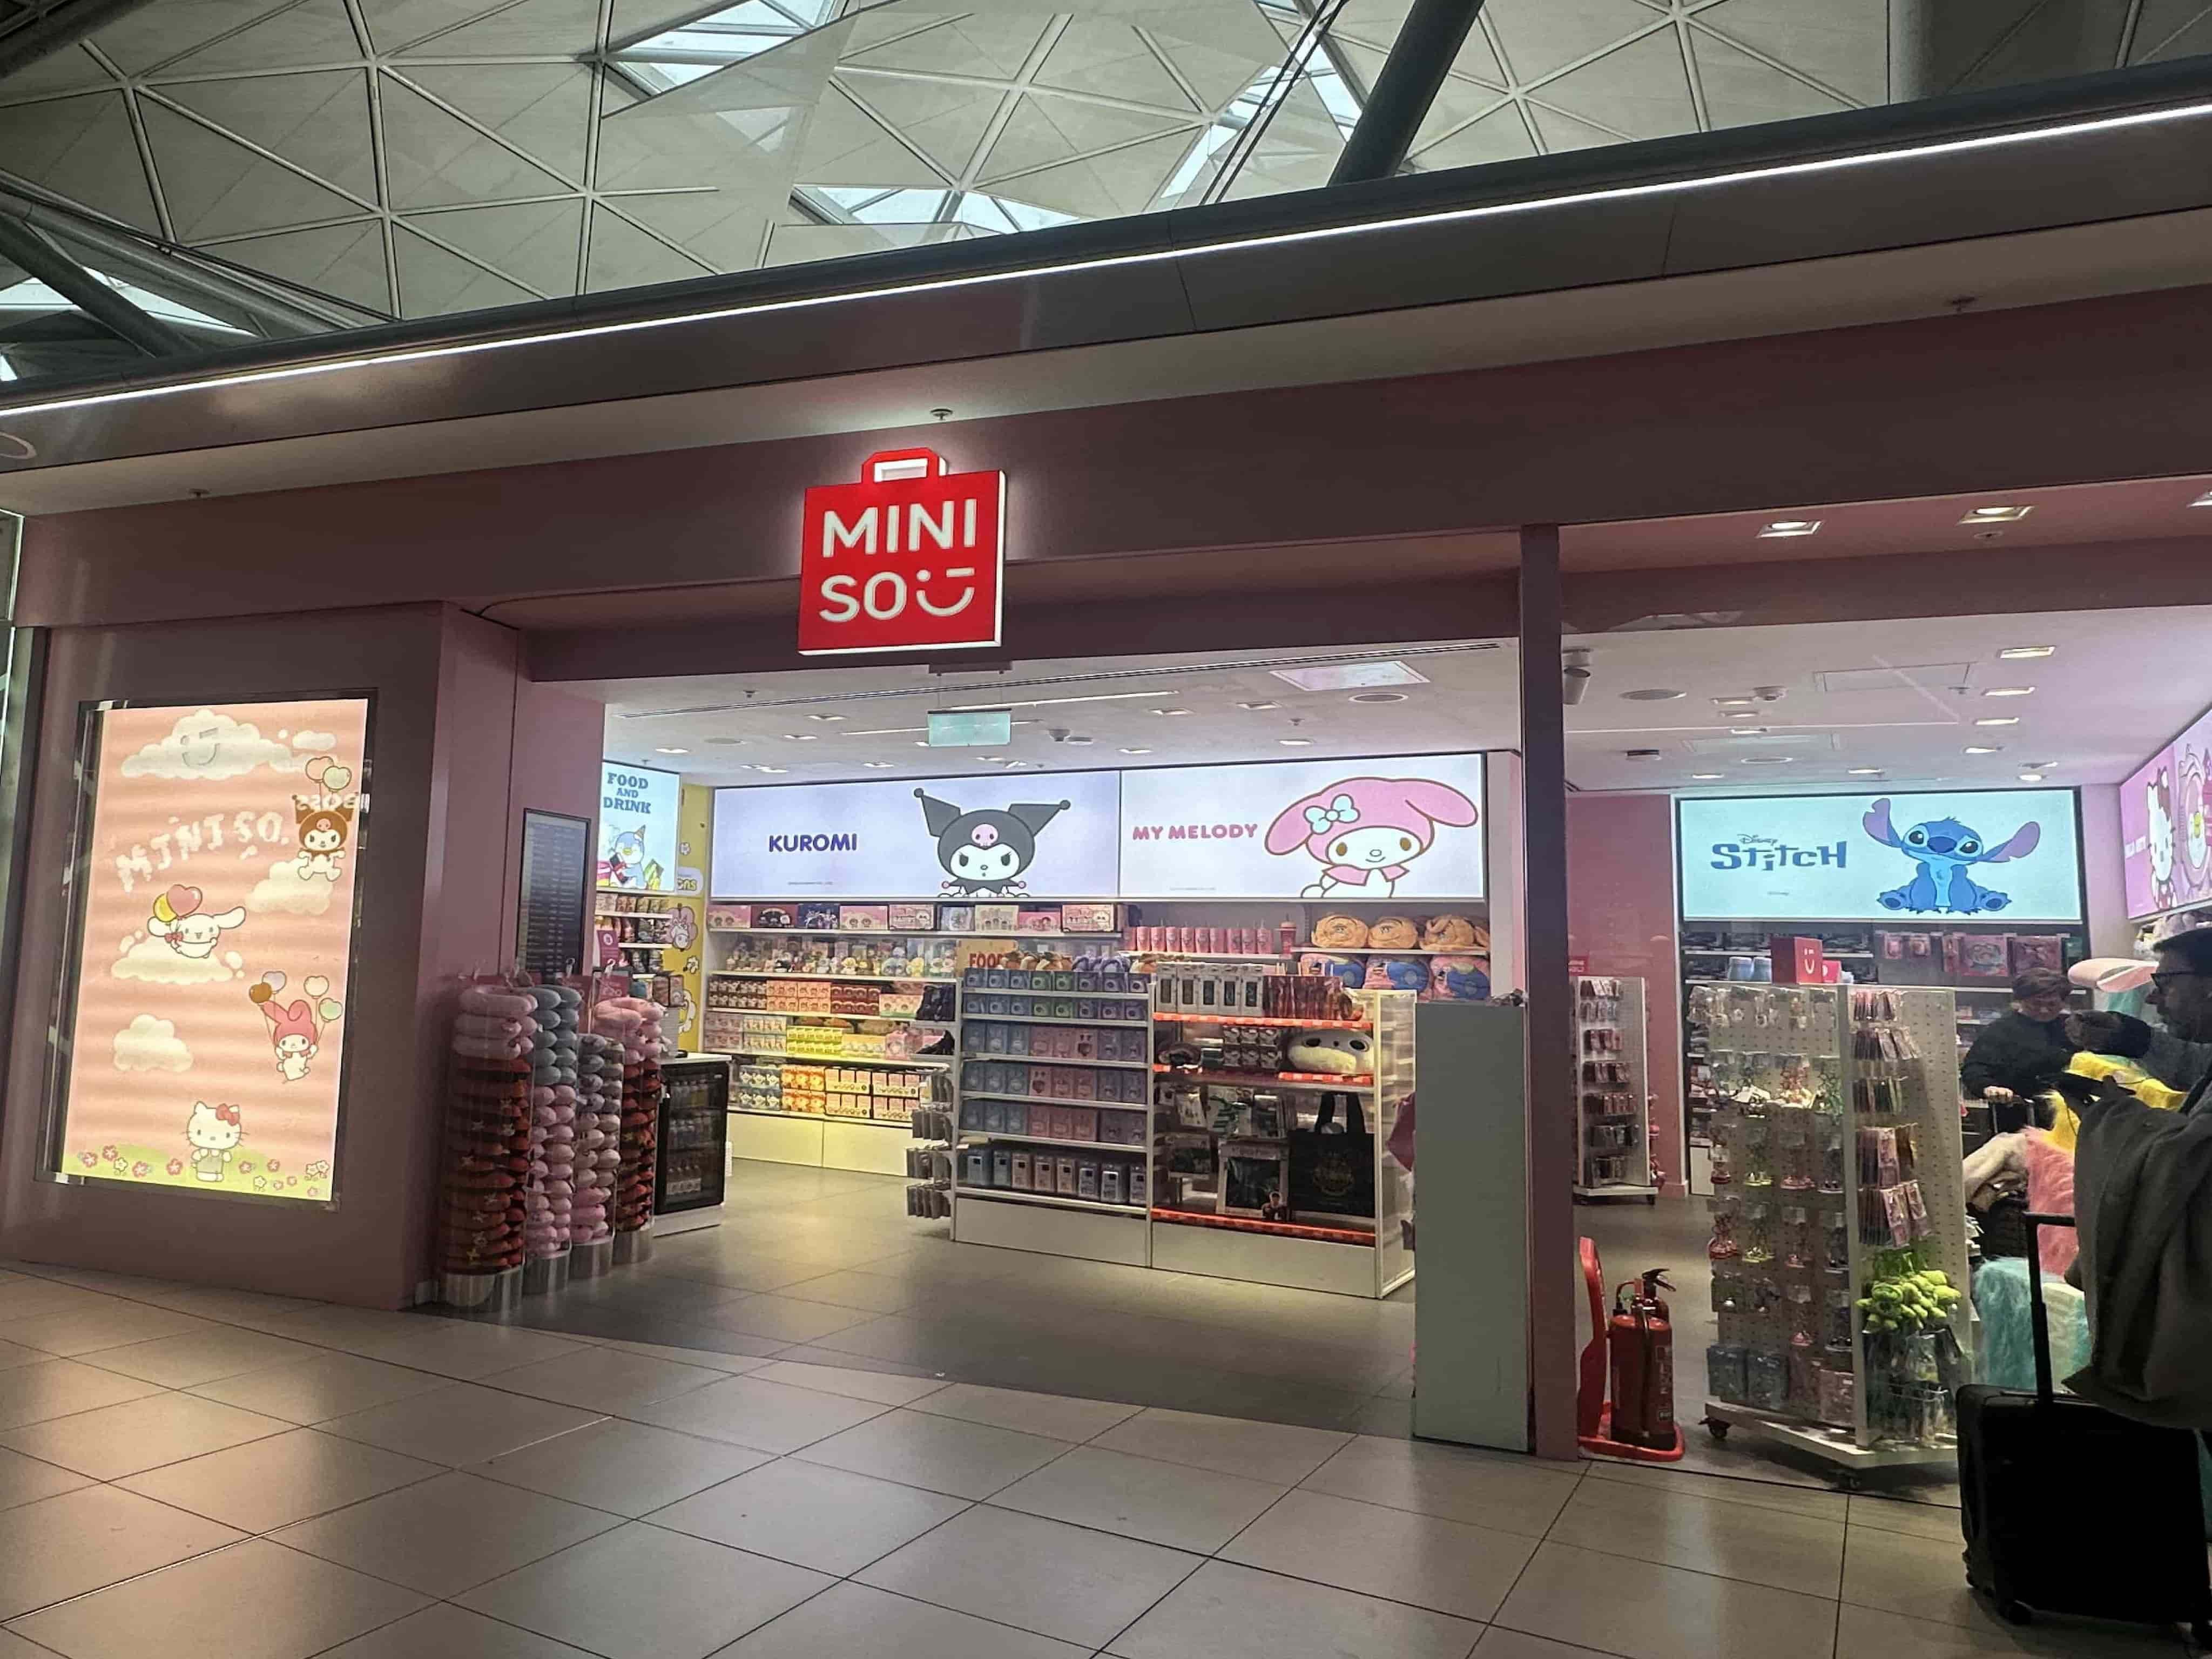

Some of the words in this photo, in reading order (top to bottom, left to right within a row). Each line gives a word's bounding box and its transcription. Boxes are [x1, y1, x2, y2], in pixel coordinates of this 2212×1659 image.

[822, 499, 977, 558] MINI
[819, 571, 907, 623] SO
[607, 772, 649, 789] FOOD
[616, 787, 639, 798] AND
[603, 797, 651, 814] DRINK
[1132, 826, 1163, 840] MY
[1168, 824, 1258, 839] MELODY
[769, 833, 858, 852] KUROMI
